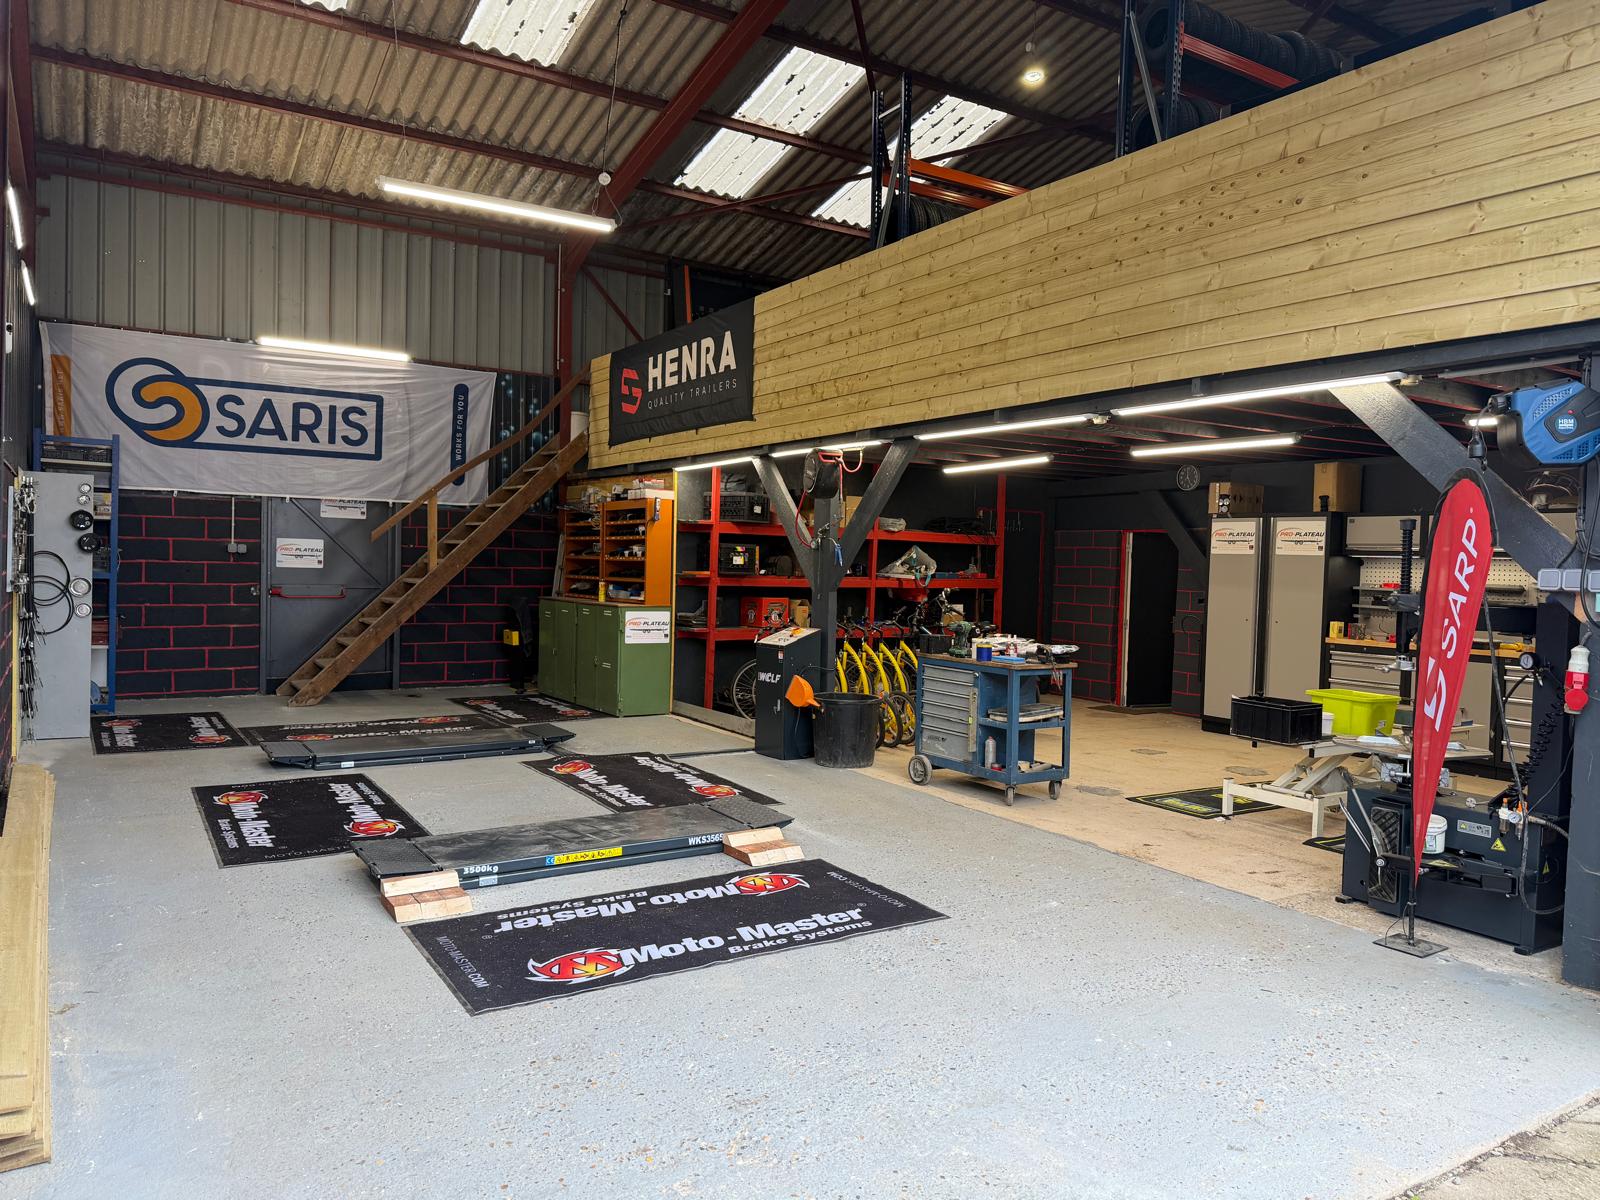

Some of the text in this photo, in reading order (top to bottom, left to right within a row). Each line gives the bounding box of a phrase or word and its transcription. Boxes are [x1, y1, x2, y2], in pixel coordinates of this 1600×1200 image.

[648, 330, 736, 392] HENRA
[648, 379, 737, 409] QUALITY TRAILERS
[216, 394, 368, 447] SARIS
[1441, 518, 1478, 659] SARP
[463, 865, 499, 874] 3500kg
[497, 891, 648, 920] Brake Systems
[727, 920, 873, 954] Brake Systems
